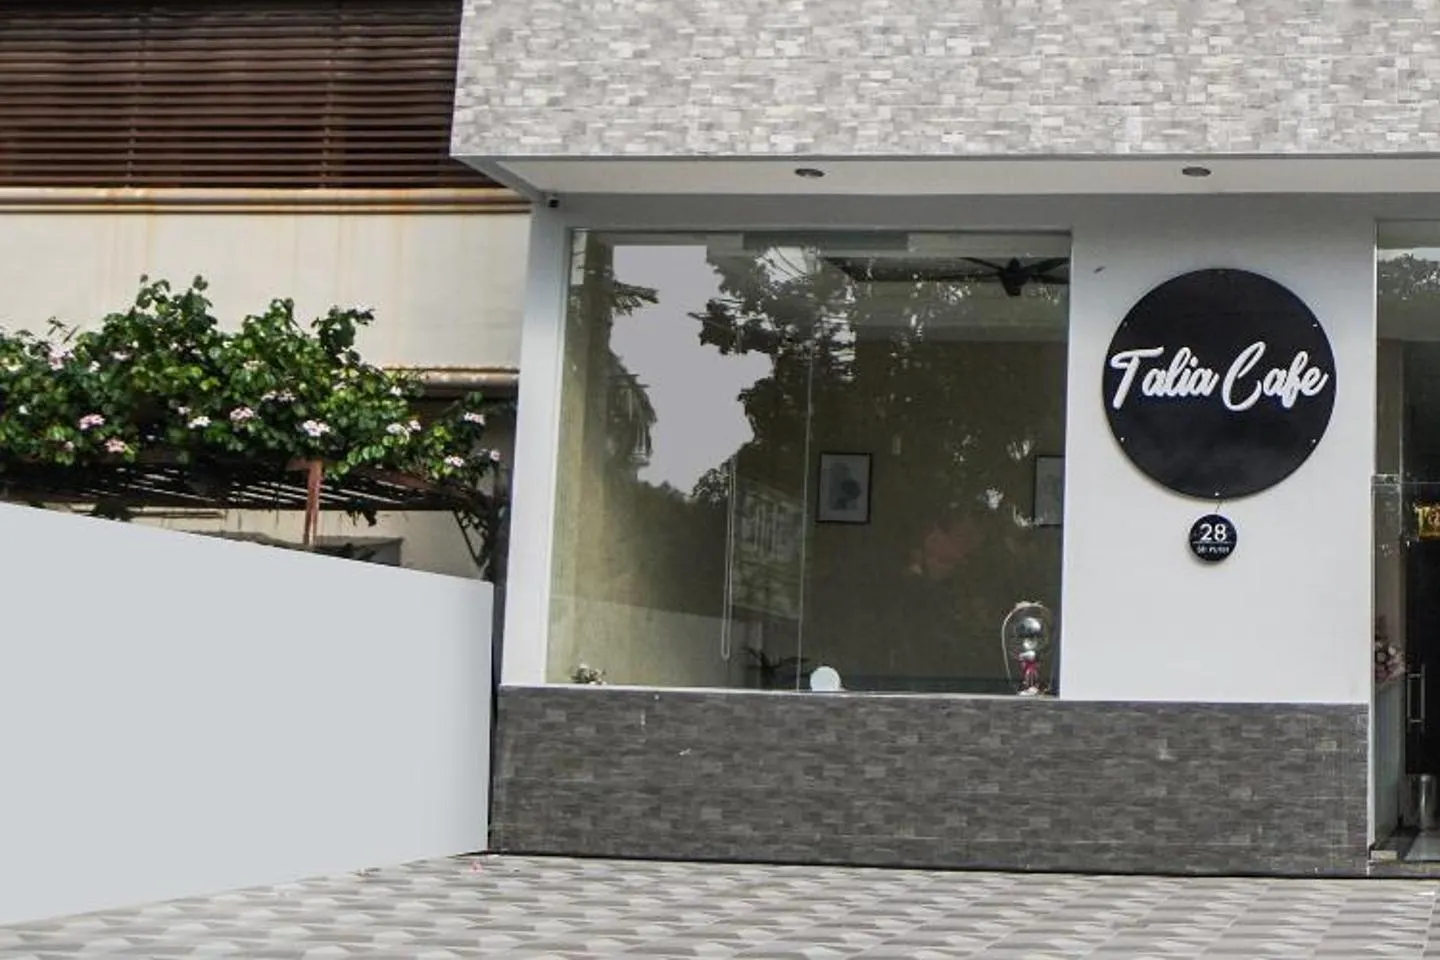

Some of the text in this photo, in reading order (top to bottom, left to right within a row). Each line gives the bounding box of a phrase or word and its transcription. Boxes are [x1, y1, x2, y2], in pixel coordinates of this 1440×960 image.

[1110, 340, 1329, 412] Talia Cafe
[1200, 523, 1227, 542] 28
